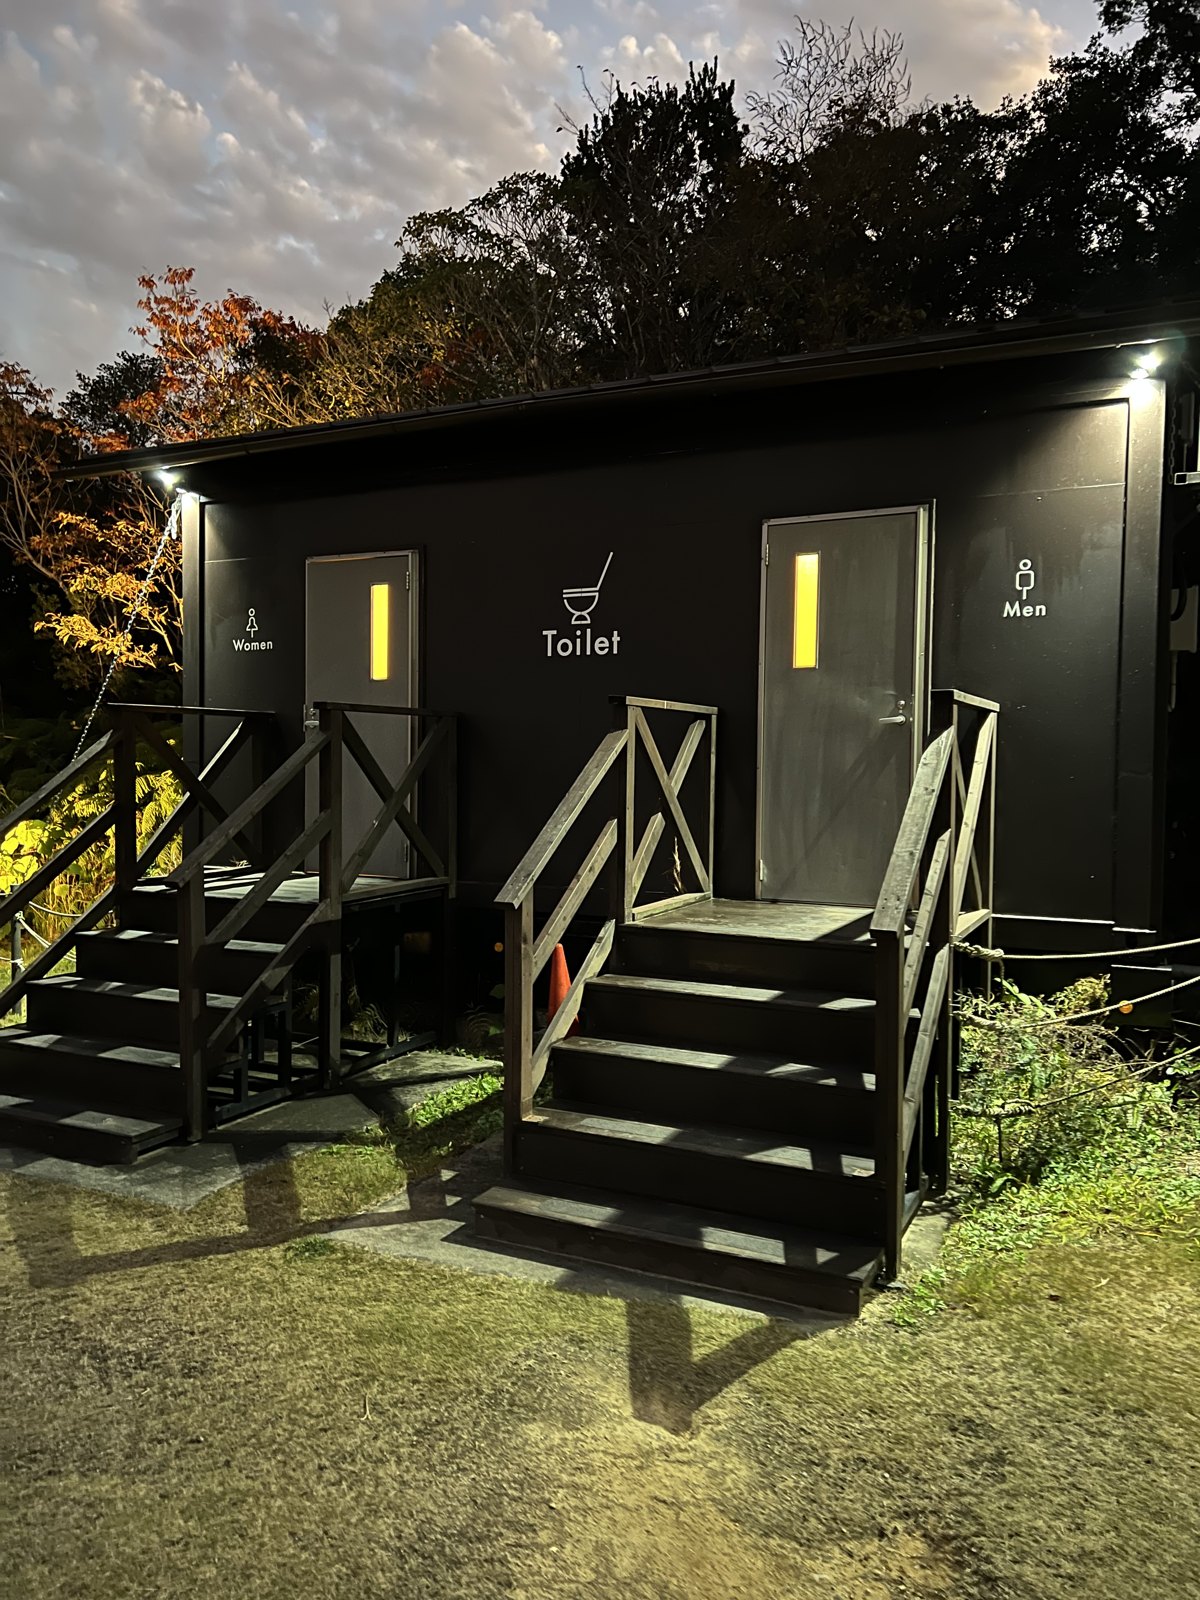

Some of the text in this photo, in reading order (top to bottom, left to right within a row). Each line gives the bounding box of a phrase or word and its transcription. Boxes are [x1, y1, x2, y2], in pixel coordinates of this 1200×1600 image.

[1002, 601, 1047, 618] Men
[232, 638, 273, 651] Women
[542, 628, 621, 657] Toilet
